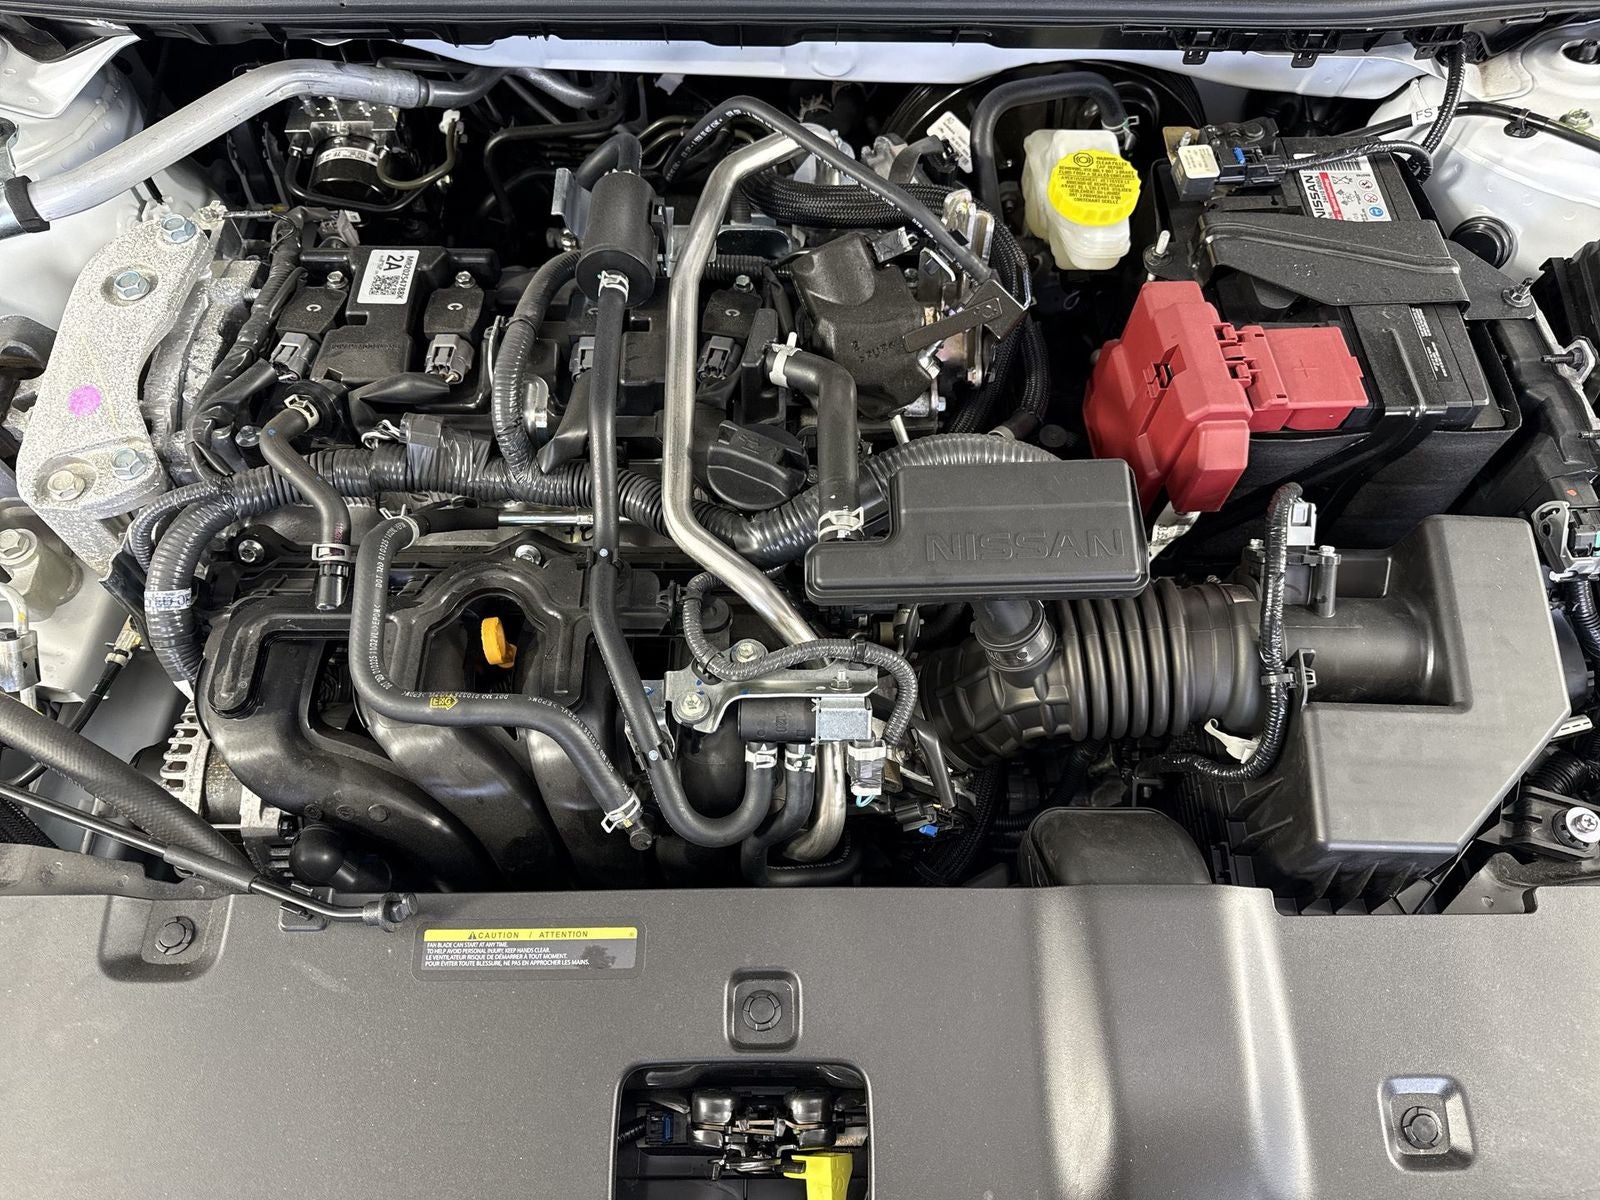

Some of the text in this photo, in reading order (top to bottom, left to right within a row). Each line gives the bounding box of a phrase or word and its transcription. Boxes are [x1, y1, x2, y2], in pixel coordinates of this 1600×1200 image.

[1416, 108, 1432, 120] FS
[1304, 175, 1325, 218] NISSAN
[384, 254, 404, 271] 2A
[926, 528, 1125, 561] NISSAN
